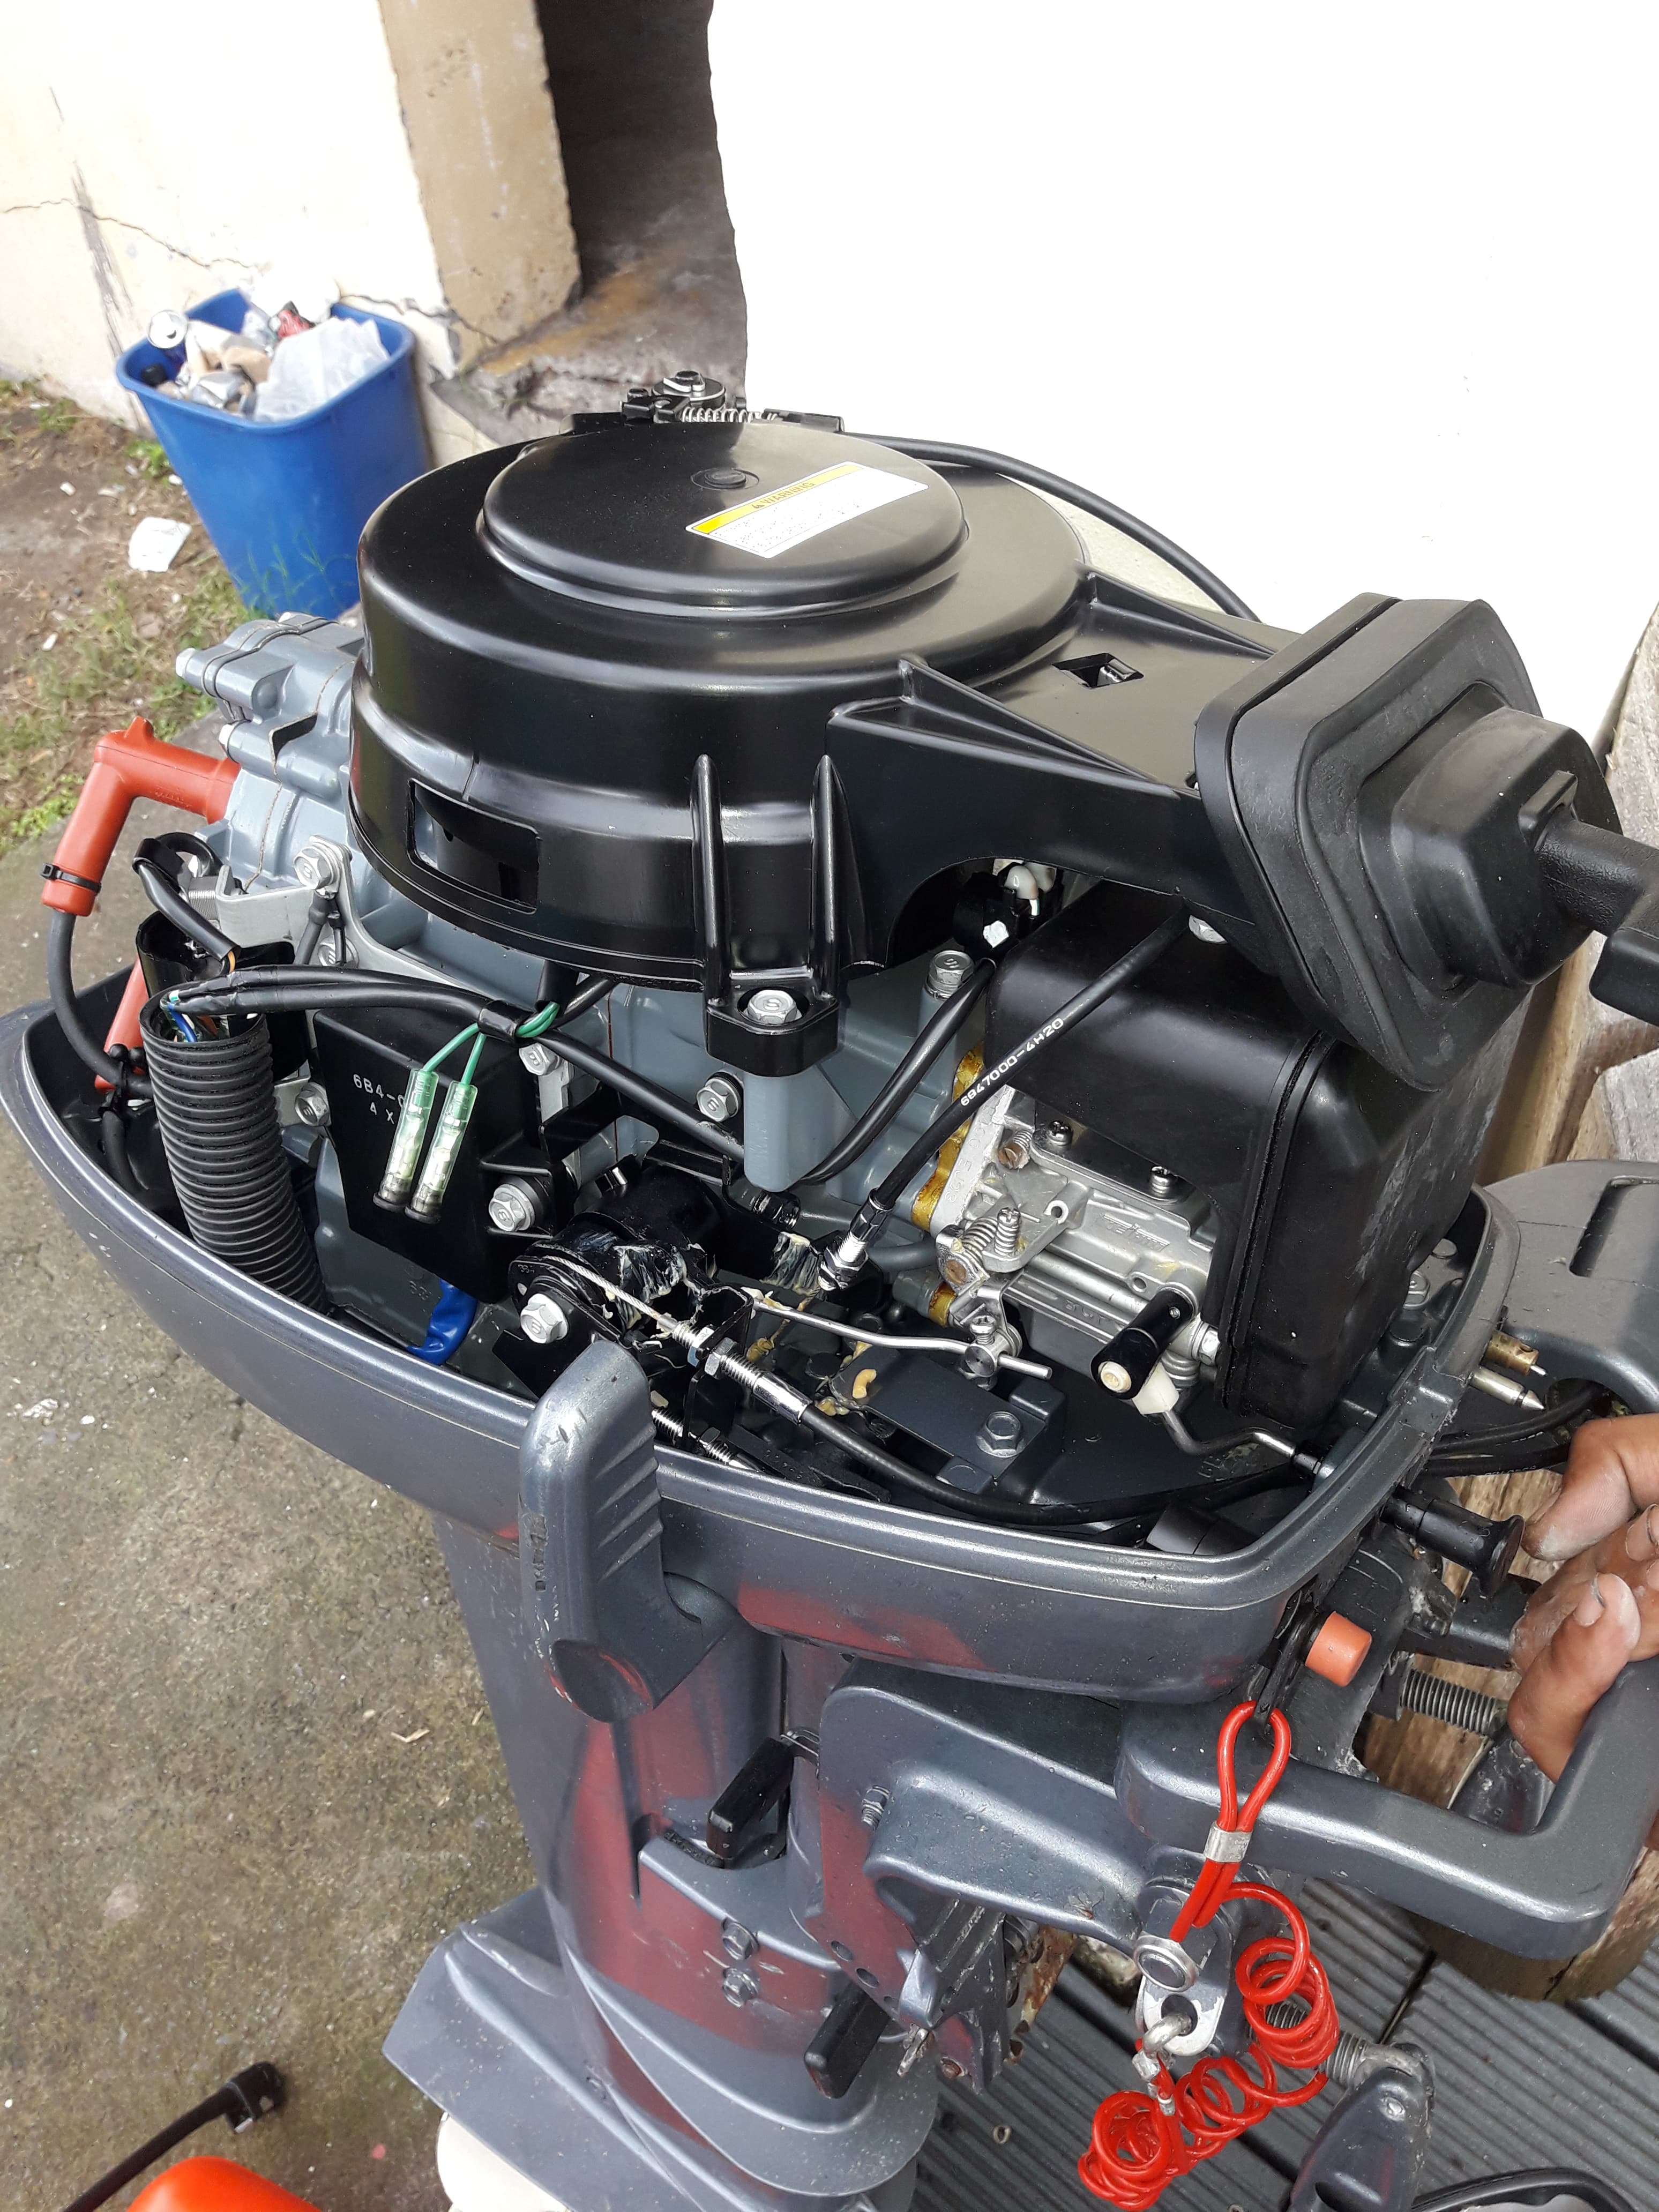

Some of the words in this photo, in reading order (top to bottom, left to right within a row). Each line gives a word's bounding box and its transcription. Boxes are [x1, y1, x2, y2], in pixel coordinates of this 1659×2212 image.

[759, 482, 816, 504] WARNING
[370, 1102, 377, 1116] 4
[385, 1108, 395, 1125] X
